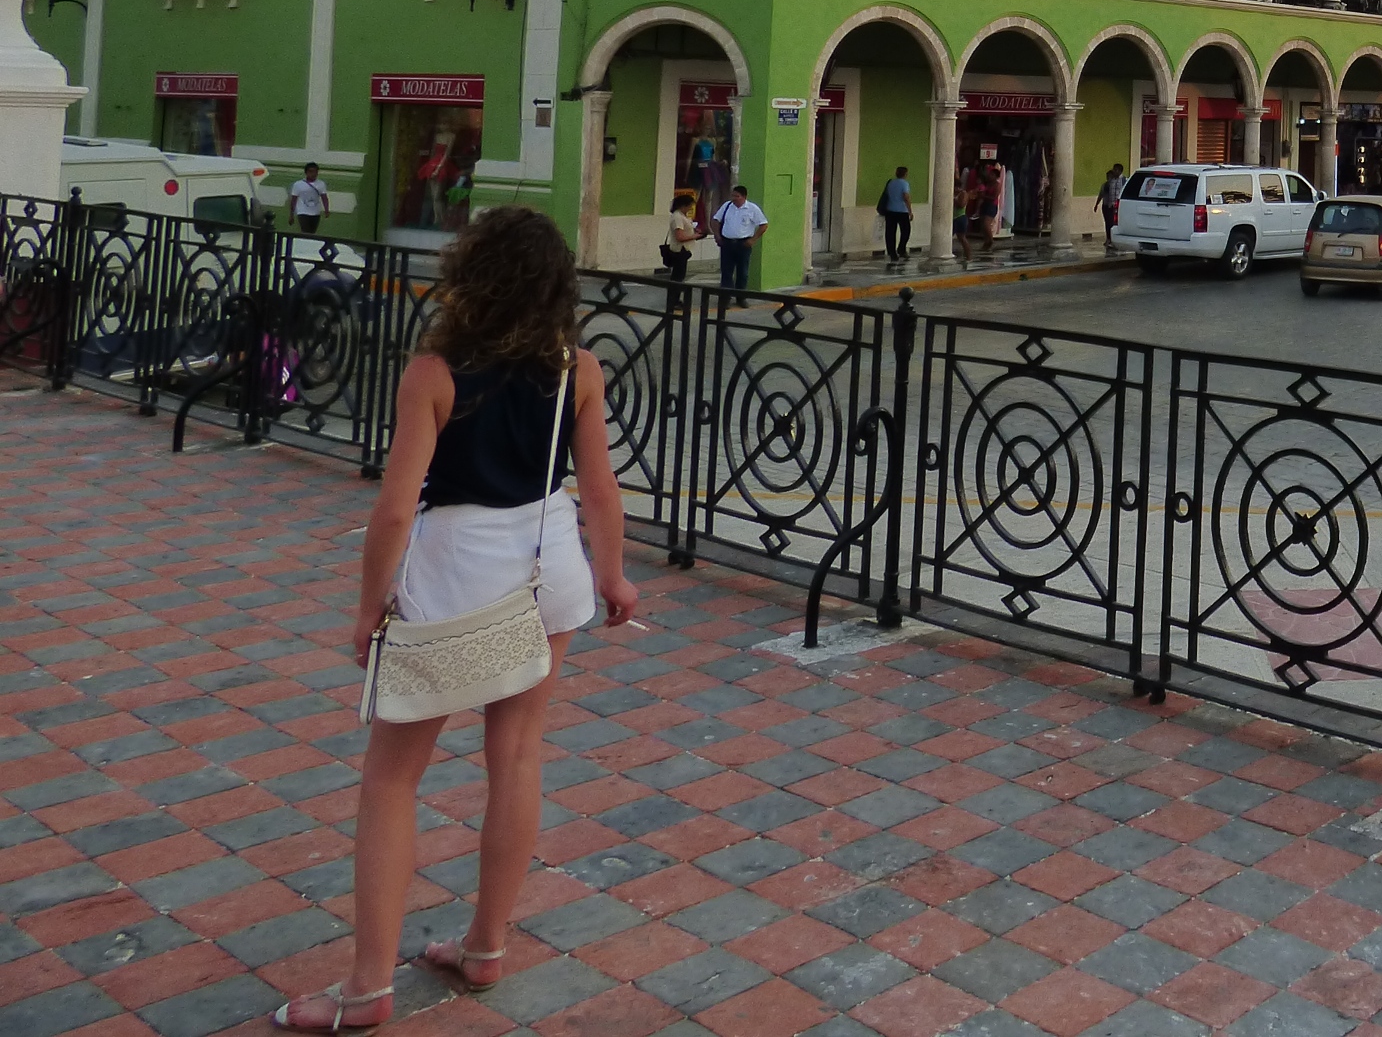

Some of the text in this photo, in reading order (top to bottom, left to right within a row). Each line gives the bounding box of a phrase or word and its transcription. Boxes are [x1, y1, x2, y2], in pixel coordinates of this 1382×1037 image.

[177, 78, 227, 91] MODATELAS
[401, 80, 467, 96] MODATELAS
[980, 95, 1048, 109] MODATELAS
